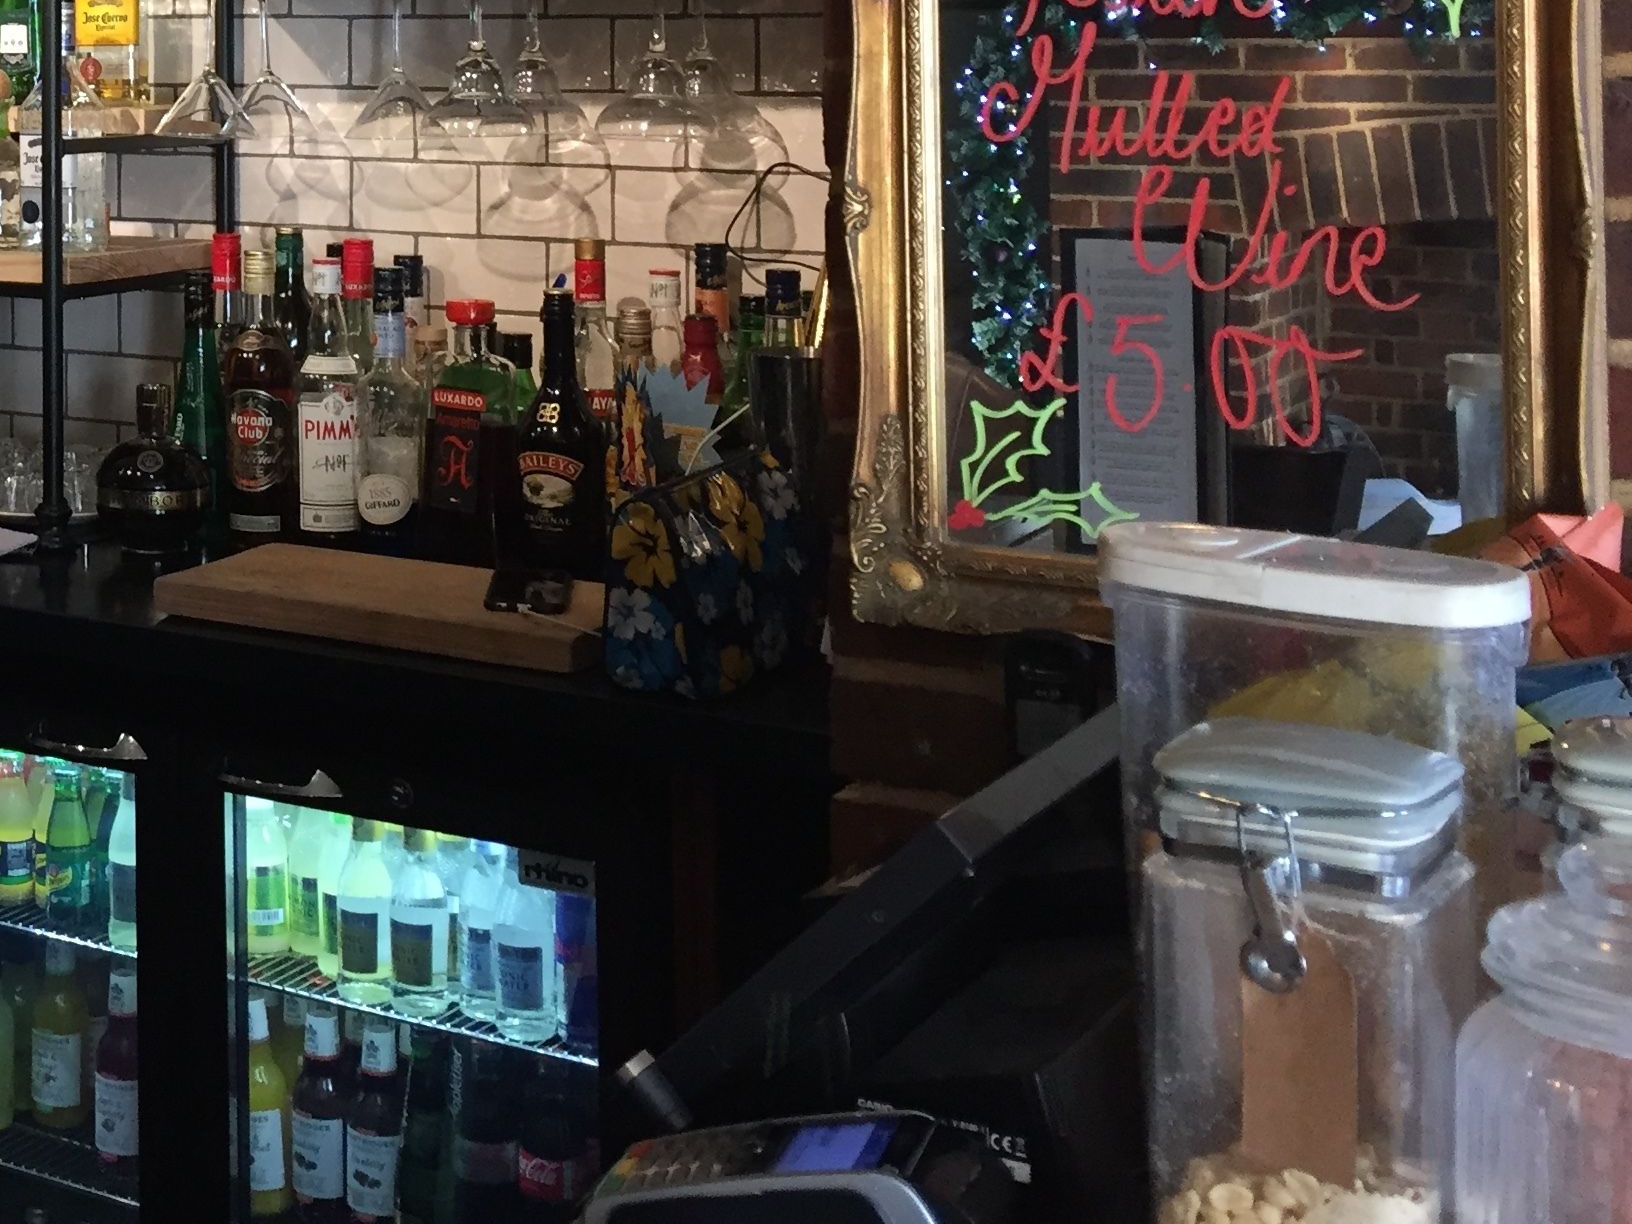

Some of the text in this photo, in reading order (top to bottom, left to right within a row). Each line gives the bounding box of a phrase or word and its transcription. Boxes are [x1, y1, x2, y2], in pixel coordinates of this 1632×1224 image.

[980, 21, 1293, 173] Mulled
[1132, 160, 1421, 312] Wine
[433, 391, 484, 408] LUXARDO
[230, 411, 273, 427] Havana
[304, 415, 356, 441] PIMM'
[237, 425, 264, 440] Club
[518, 453, 578, 476] BAILEYS
